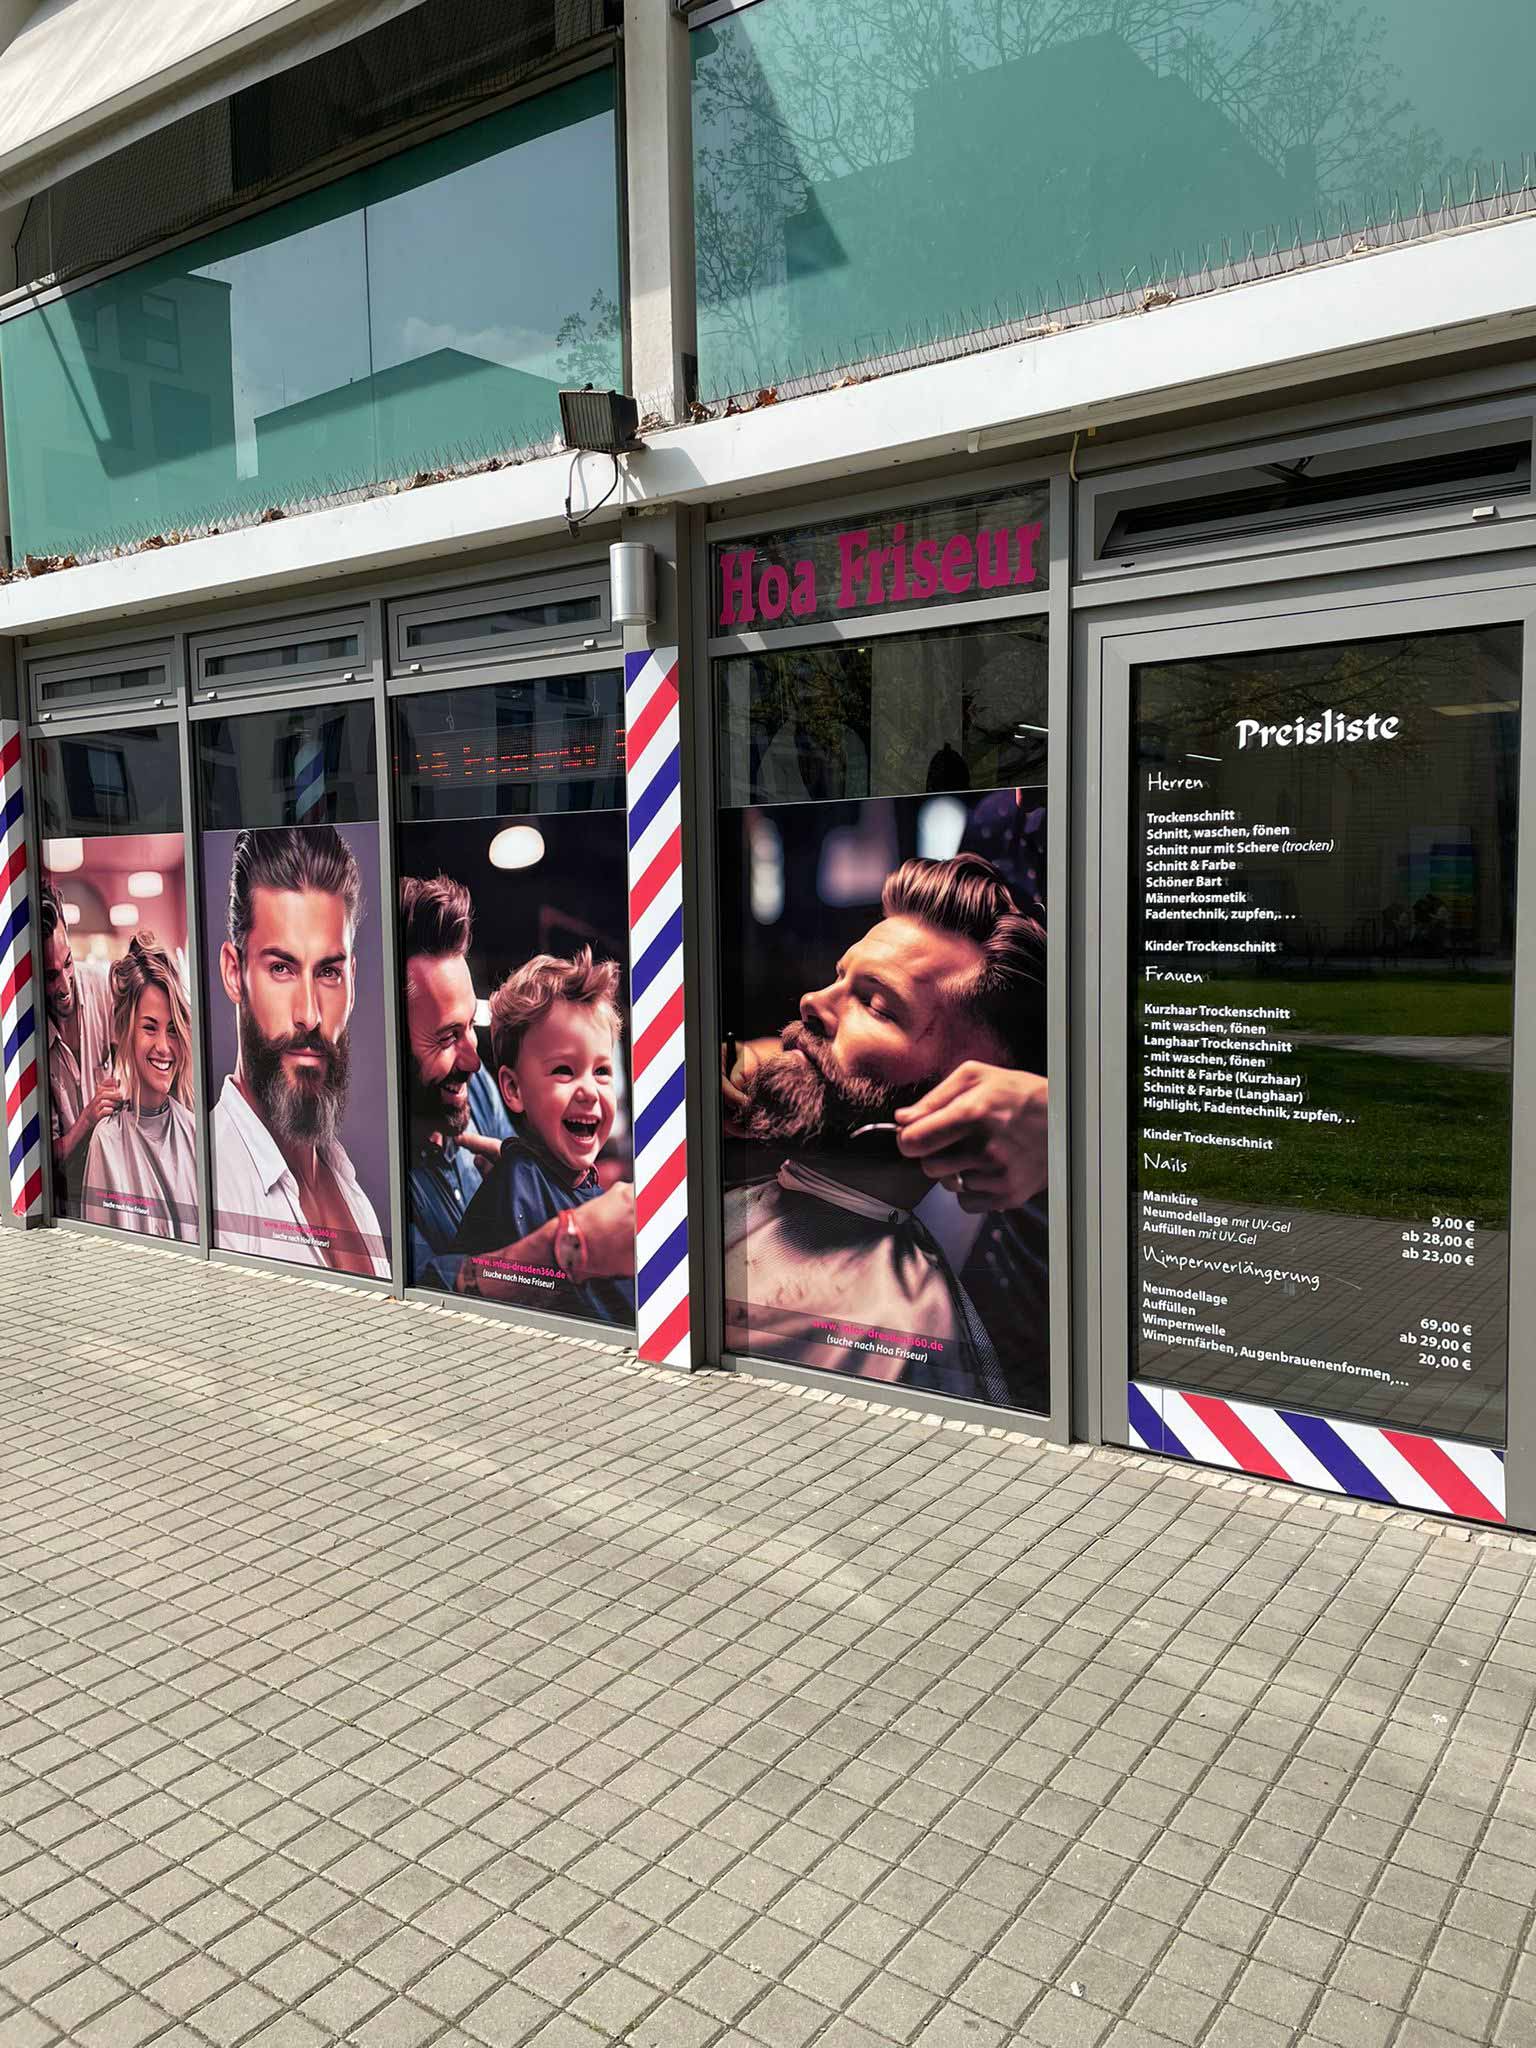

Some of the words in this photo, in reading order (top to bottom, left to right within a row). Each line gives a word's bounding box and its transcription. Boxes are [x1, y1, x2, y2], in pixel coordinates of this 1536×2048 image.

[719, 549, 816, 625] Hoa
[836, 521, 1043, 609] Friseur
[1235, 708, 1400, 750] Preisliste
[1147, 772, 1203, 791] Herren
[1147, 810, 1235, 823] Trockenschnitt
[1147, 828, 1191, 840] Schnitt,
[1194, 826, 1250, 839] waschen,
[1253, 824, 1290, 836] fönen
[1146, 844, 1189, 856] Schnitt
[1190, 846, 1211, 855] nur
[1214, 843, 1235, 854] mit
[1237, 841, 1279, 853] Schere
[1282, 839, 1334, 853] (trocken)
[1146, 860, 1188, 872] Schnitt
[1190, 861, 1200, 871] &
[1202, 859, 1236, 871] Farbe
[1146, 876, 1194, 888] Schöner
[1196, 876, 1222, 887] Bart
[1146, 892, 1247, 904] Männerkosmetik
[1145, 908, 1229, 921] Fadentechnik,
[1145, 941, 1185, 952] Kinder
[1186, 941, 1276, 953] Trockenschnitt
[1145, 966, 1203, 984] Frauen
[1144, 1003, 1198, 1016] Kurzhaar
[1199, 1005, 1290, 1019] Trockenschnitt
[1151, 1020, 1171, 1031] mit
[1172, 1022, 1227, 1034] waschen,
[1229, 1023, 1266, 1035] fönen
[1144, 1035, 1199, 1049] Langhaar
[1201, 1037, 1292, 1053] Trockenschnitt
[1151, 1051, 1171, 1063] mit
[1172, 1053, 1227, 1067] waschen,
[1229, 1055, 1266, 1068] fönen
[1144, 1066, 1185, 1079] Schnitt
[1187, 1068, 1197, 1080] &
[1199, 1069, 1233, 1082] Farbe
[1235, 1072, 1301, 1087] (Kurzhaar)
[1144, 1082, 1185, 1095] Schnitt
[1187, 1085, 1197, 1096] &
[1199, 1085, 1233, 1098] Farbe
[1235, 1088, 1303, 1104] (Langhaar)
[1144, 1097, 1202, 1113] Highlight,
[1204, 1101, 1291, 1120] Fadentechnik,
[1144, 1128, 1181, 1142] Kinder
[1144, 1153, 1188, 1173] Nails
[1143, 1190, 1199, 1206] Maniküre
[1143, 1205, 1229, 1227] Neumodellage
[1232, 1218, 1250, 1228] mit
[1252, 1219, 1292, 1233] UV-Gel
[1432, 1216, 1463, 1230] 9,00
[1466, 1220, 1475, 1232] €
[1143, 1221, 1196, 1237] Auffüllen
[1199, 1229, 1217, 1240] mit
[1219, 1230, 1257, 1245] UV-Gel
[1402, 1230, 1419, 1242] ab
[1423, 1232, 1462, 1247] 28,00
[1465, 1238, 1474, 1249] €
[1402, 1247, 1419, 1259] ab
[1422, 1250, 1462, 1265] 23,00
[1465, 1255, 1474, 1266] €
[1143, 1245, 1320, 1291] Wimpernverlängerung
[483, 1269, 502, 1280] (suche
[502, 1273, 517, 1283] nach
[518, 1275, 531, 1285] Hoa
[531, 1277, 555, 1289] Friseur)
[1143, 1280, 1228, 1306] Neumodellage
[1143, 1298, 1196, 1316] Auffüllen
[1143, 1314, 1227, 1337] Wimpernwelle
[1420, 1318, 1460, 1334] 69,00
[1463, 1325, 1472, 1336] €
[827, 1334, 853, 1347] (suche
[854, 1340, 875, 1352] nach
[876, 1343, 894, 1355] Hoa
[895, 1347, 928, 1363] Friseur)
[1143, 1328, 1238, 1357] Wimpernfärben,
[1400, 1332, 1417, 1344] ab
[1420, 1335, 1459, 1351] 29,00
[1462, 1342, 1472, 1354] €
[1419, 1353, 1458, 1369] 20,00
[1462, 1359, 1472, 1371] €
